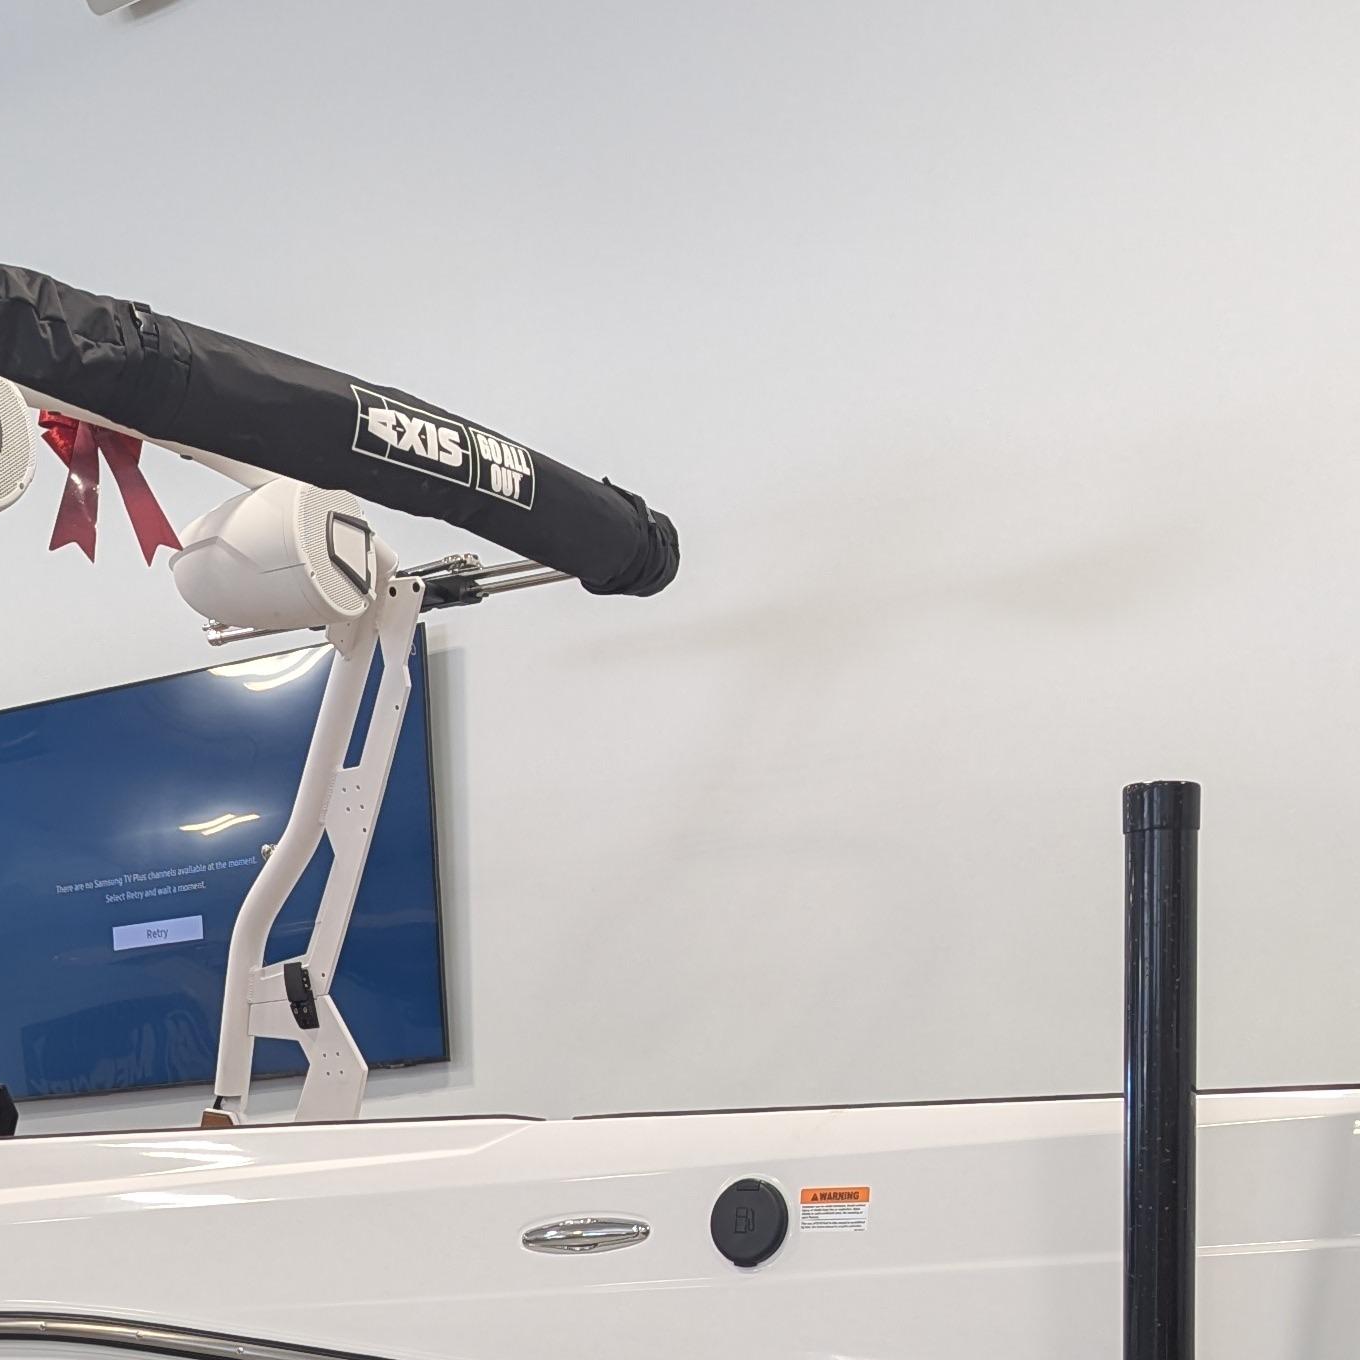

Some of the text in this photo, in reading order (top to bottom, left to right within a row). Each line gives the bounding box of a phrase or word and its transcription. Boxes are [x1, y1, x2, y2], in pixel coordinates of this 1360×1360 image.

[368, 407, 463, 467] AXIS
[477, 433, 531, 476] GO ALL
[490, 463, 523, 500] OUT
[56, 884, 74, 894] There
[74, 883, 84, 892] are
[94, 878, 123, 888] Samsung
[124, 874, 132, 883] TV
[133, 873, 147, 882] Plus
[148, 868, 176, 880] channels
[178, 863, 206, 876] available
[215, 861, 227, 870] the
[105, 893, 126, 903] Select
[126, 890, 144, 901] Retry
[145, 888, 157, 898] and
[157, 884, 172, 895] wait
[146, 928, 169, 939] Retry
[819, 1191, 860, 1201] WARNING
